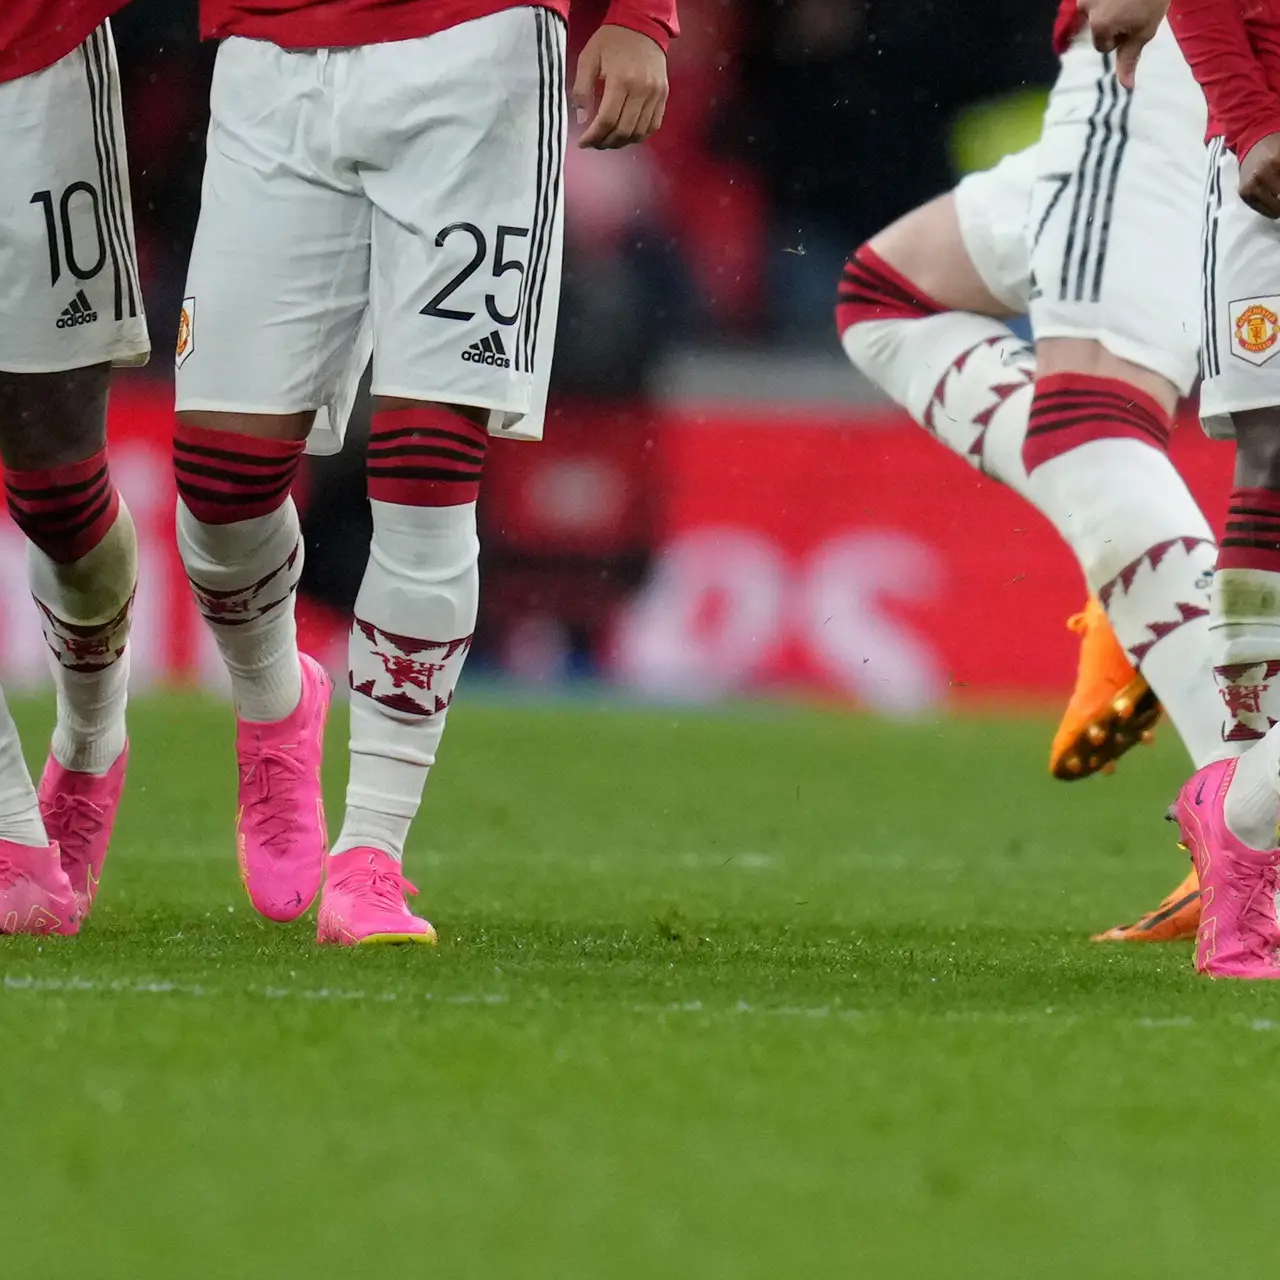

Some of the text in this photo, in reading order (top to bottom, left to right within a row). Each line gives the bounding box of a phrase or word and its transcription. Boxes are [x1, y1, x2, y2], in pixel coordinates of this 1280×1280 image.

[29, 181, 107, 288] 10
[419, 222, 530, 326] 25
[56, 311, 98, 329] adidas
[461, 350, 511, 369] adidas
